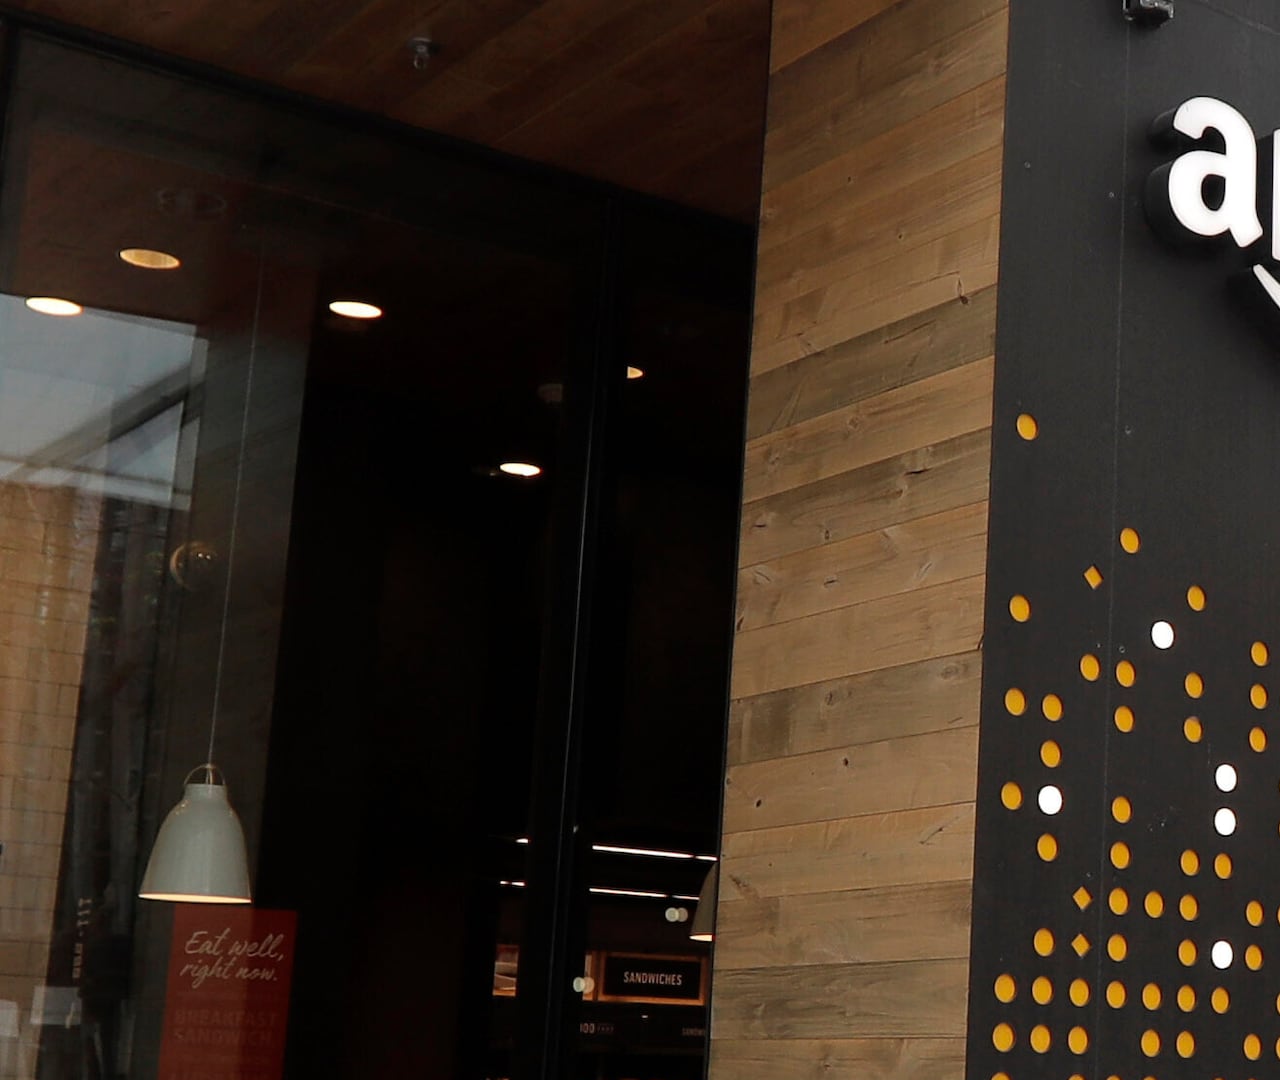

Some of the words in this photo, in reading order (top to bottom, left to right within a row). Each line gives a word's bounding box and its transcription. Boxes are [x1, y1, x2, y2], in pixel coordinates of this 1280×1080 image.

[184, 928, 231, 955] Eat
[230, 933, 286, 962] well,
[179, 956, 237, 989] right
[235, 966, 278, 982] now.
[623, 971, 683, 987] SANDWICHES
